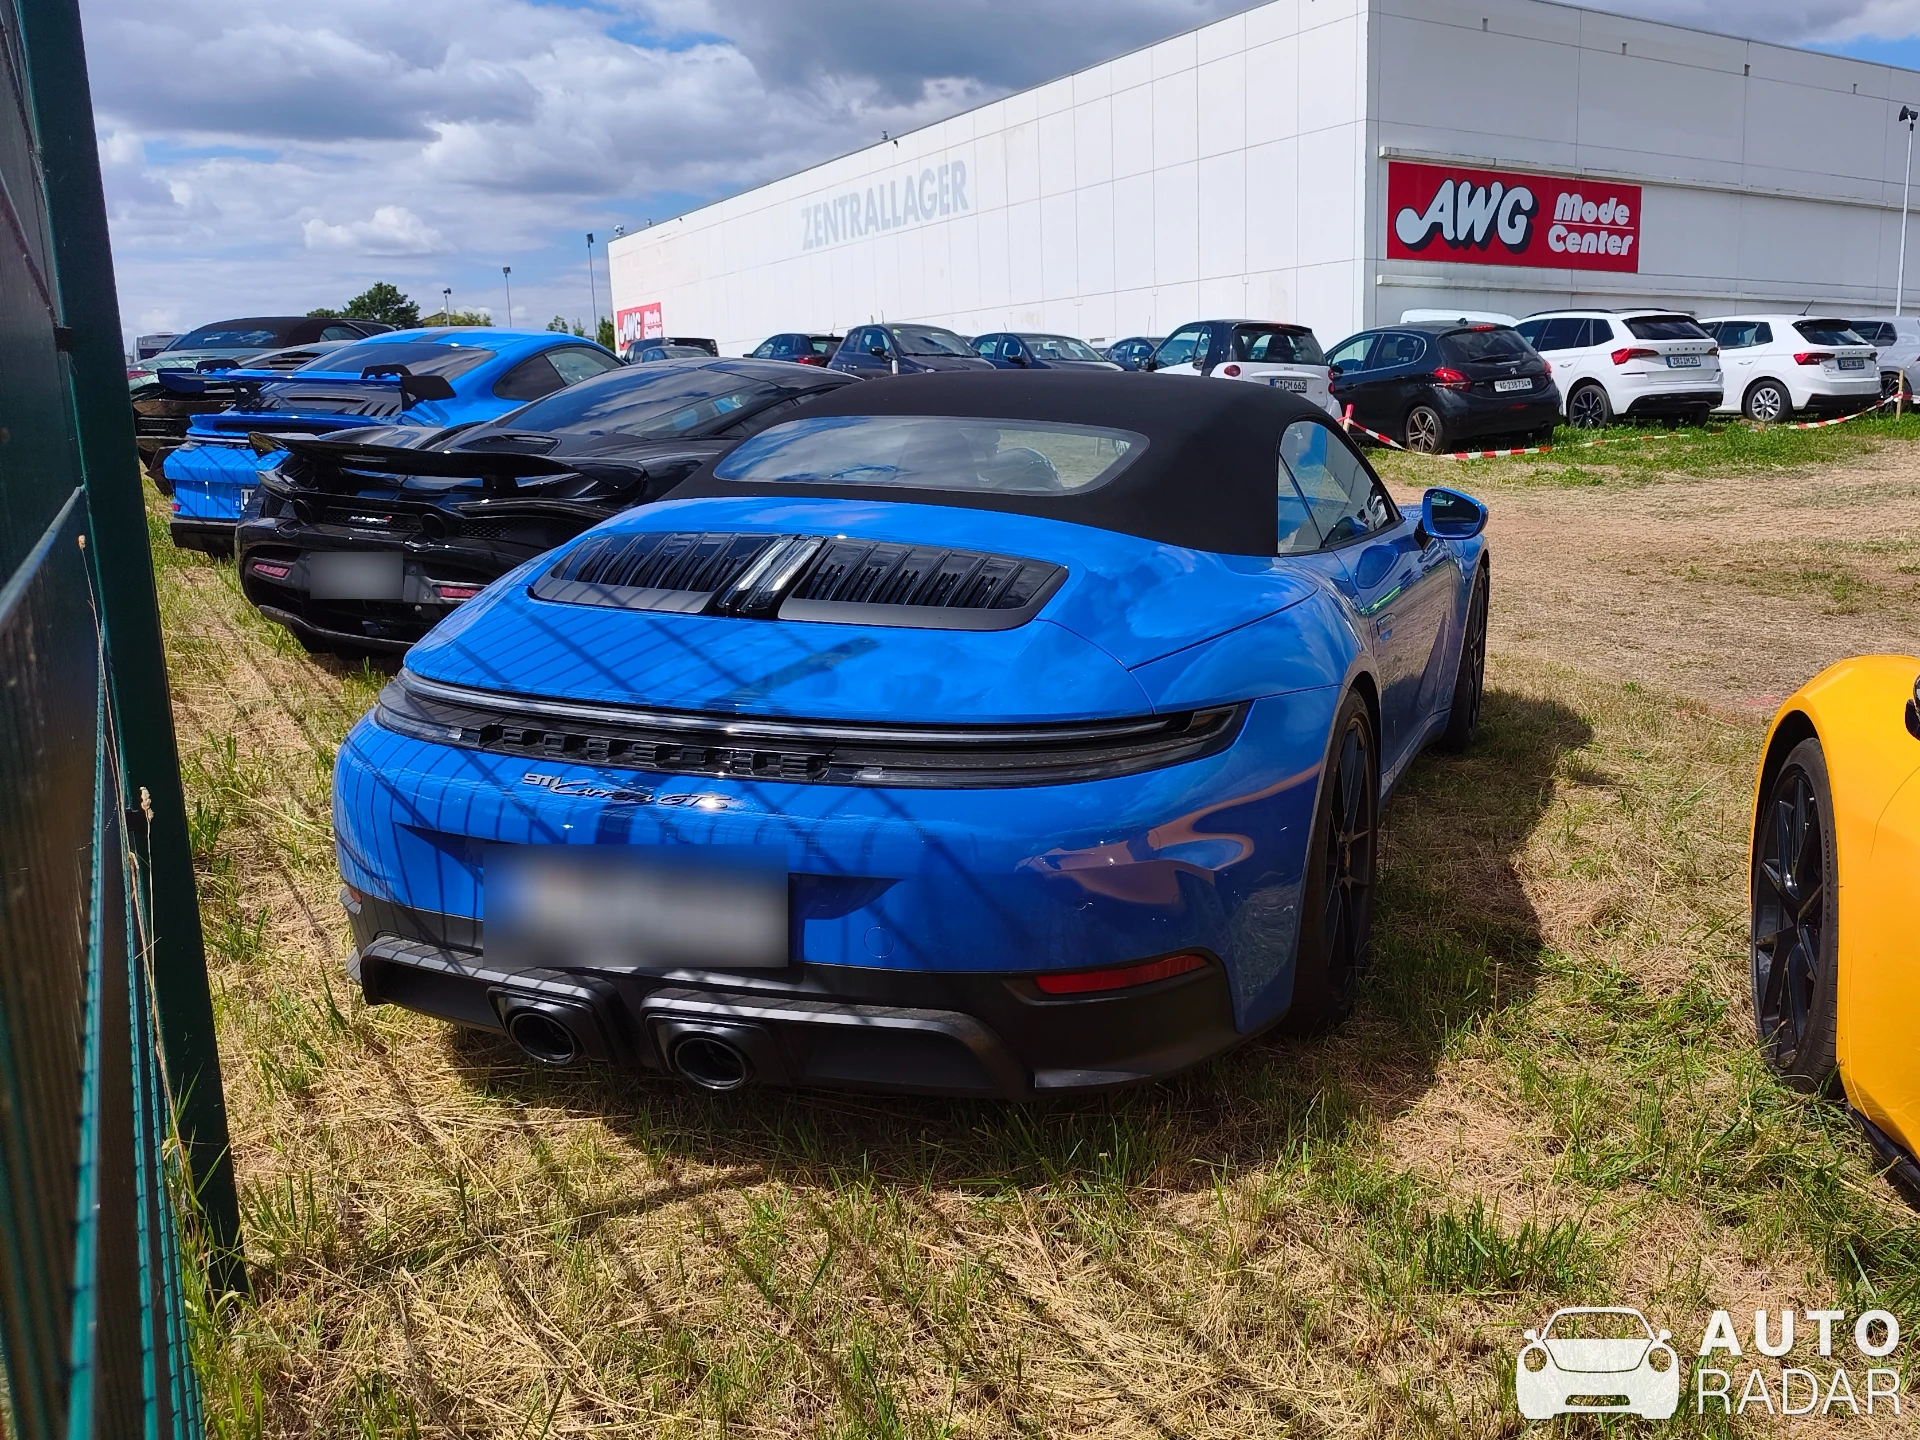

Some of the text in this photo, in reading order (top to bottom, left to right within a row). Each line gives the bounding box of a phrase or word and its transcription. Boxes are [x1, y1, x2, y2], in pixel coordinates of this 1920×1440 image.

[801, 160, 969, 251] ZENTRALLAGER
[1395, 179, 1537, 250] AWG
[1554, 192, 1630, 225] Mode
[1548, 224, 1634, 256] Center
[1294, 381, 1306, 390] 662
[522, 772, 732, 809] 911 Carrera GTS
